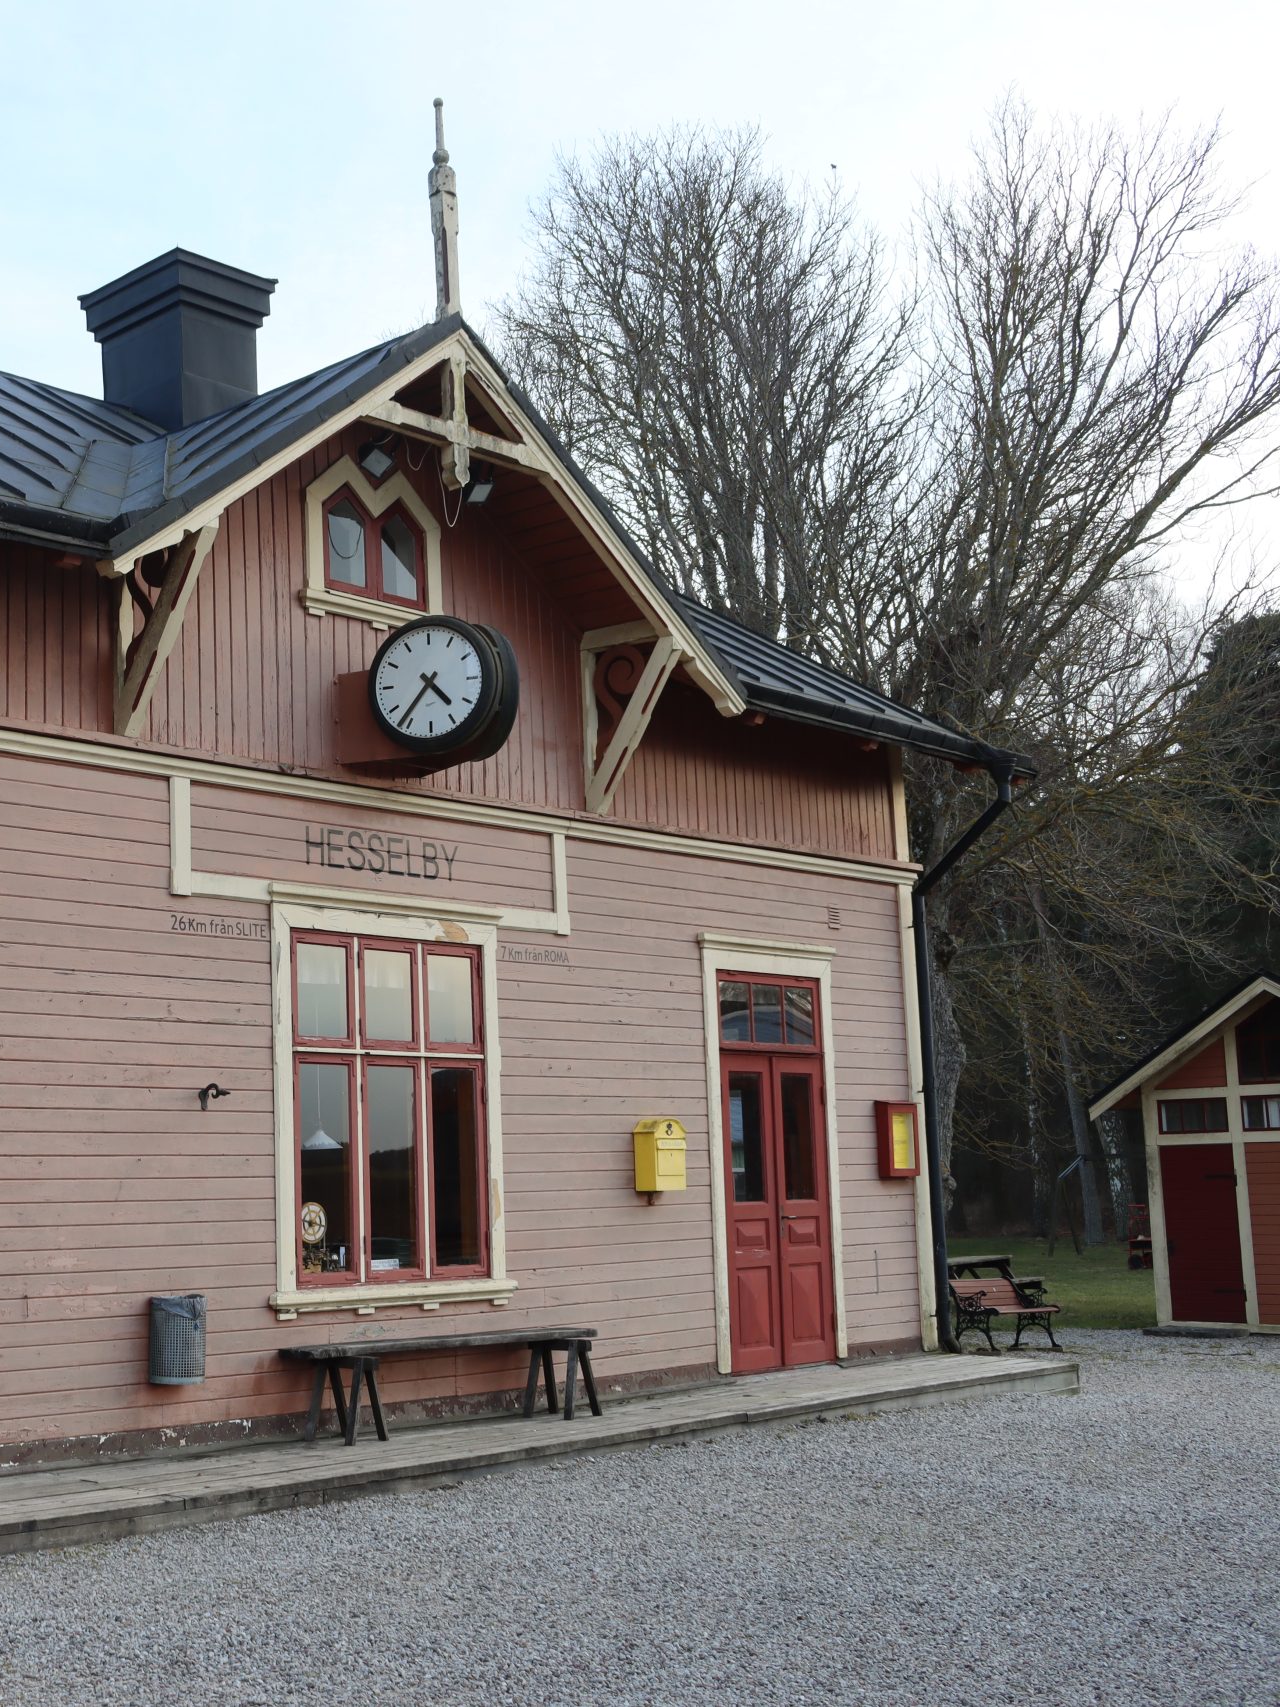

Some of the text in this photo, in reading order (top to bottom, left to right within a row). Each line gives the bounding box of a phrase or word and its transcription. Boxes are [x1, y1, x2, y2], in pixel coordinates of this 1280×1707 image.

[305, 826, 459, 882] HESSELBY
[171, 914, 267, 938] 26 Km från SLITE
[501, 945, 570, 963] 7 Km från ROMA
